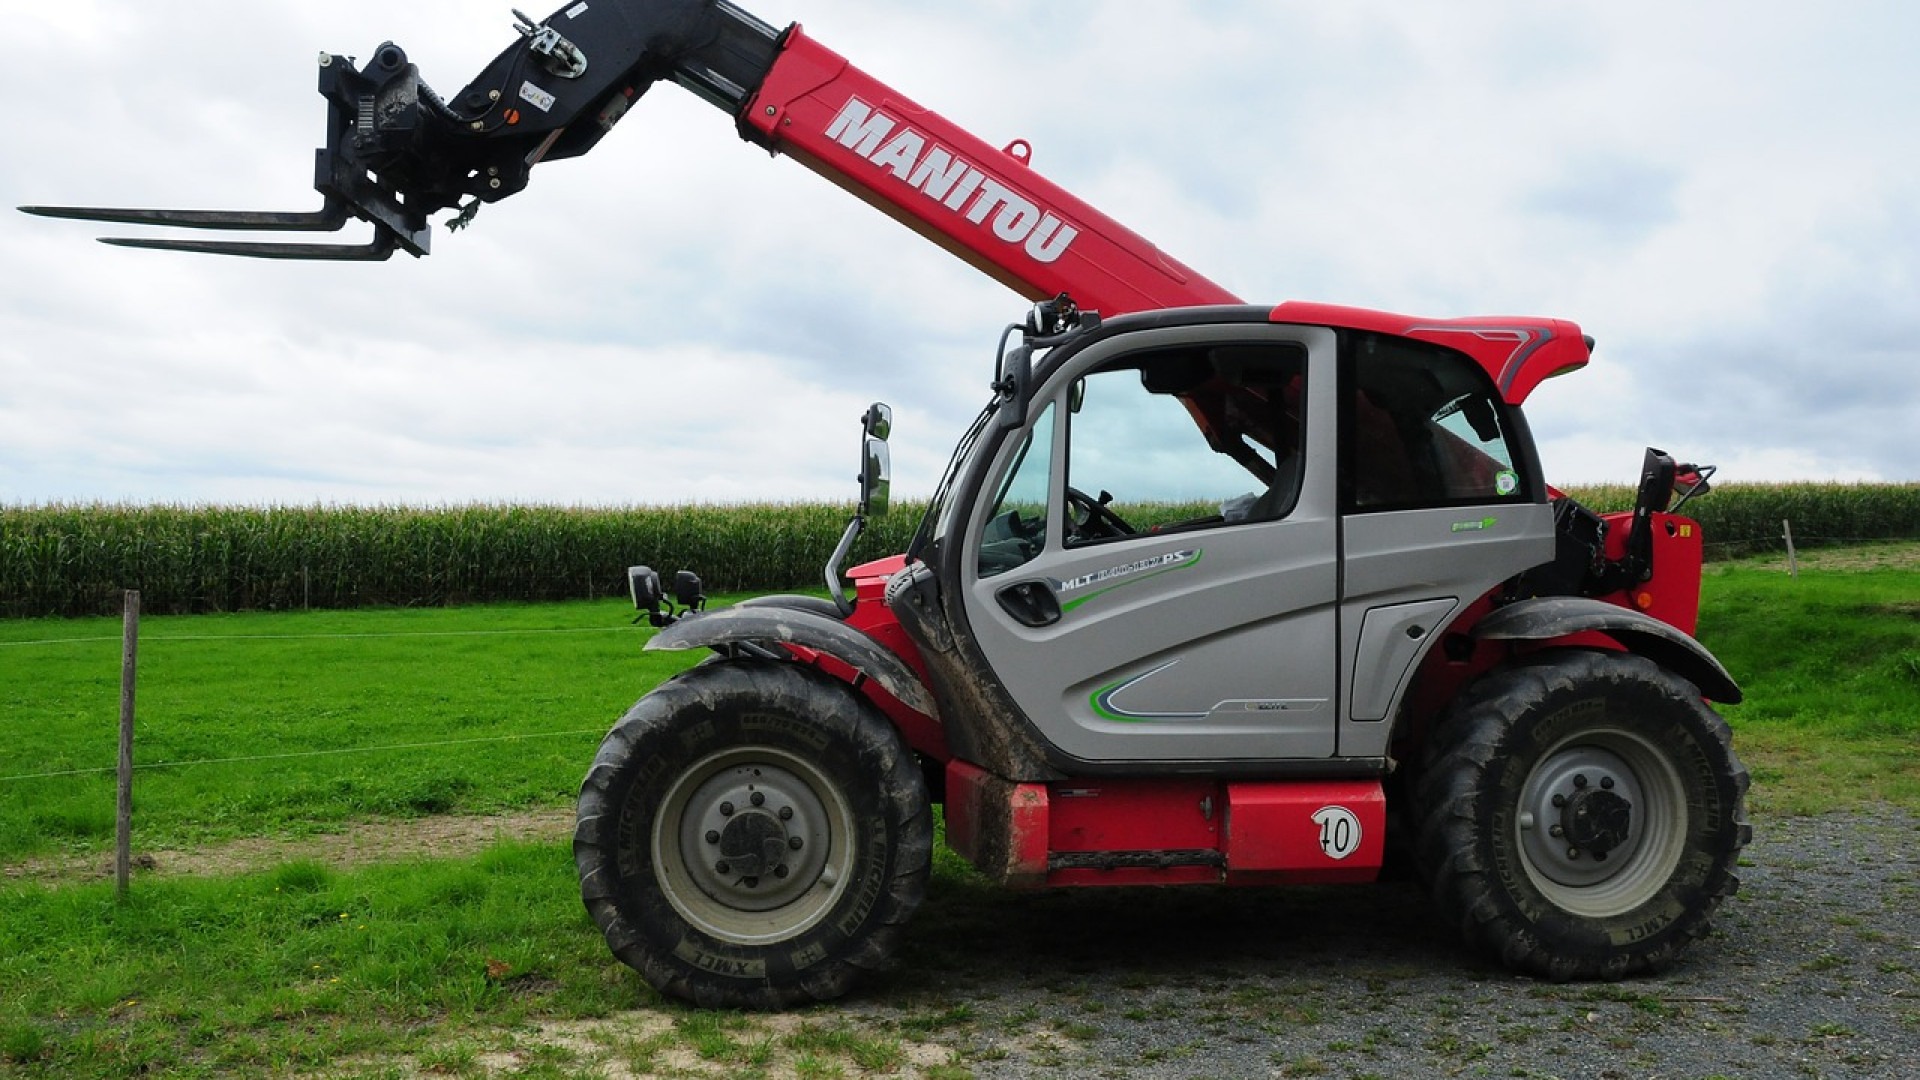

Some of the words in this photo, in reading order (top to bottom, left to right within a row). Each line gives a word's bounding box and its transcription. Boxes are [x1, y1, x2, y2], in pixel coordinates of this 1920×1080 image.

[824, 95, 1079, 264] MANITOU
[1061, 573, 1095, 591] MLT
[1163, 550, 1185, 564] PS
[1321, 817, 1350, 852] 10
